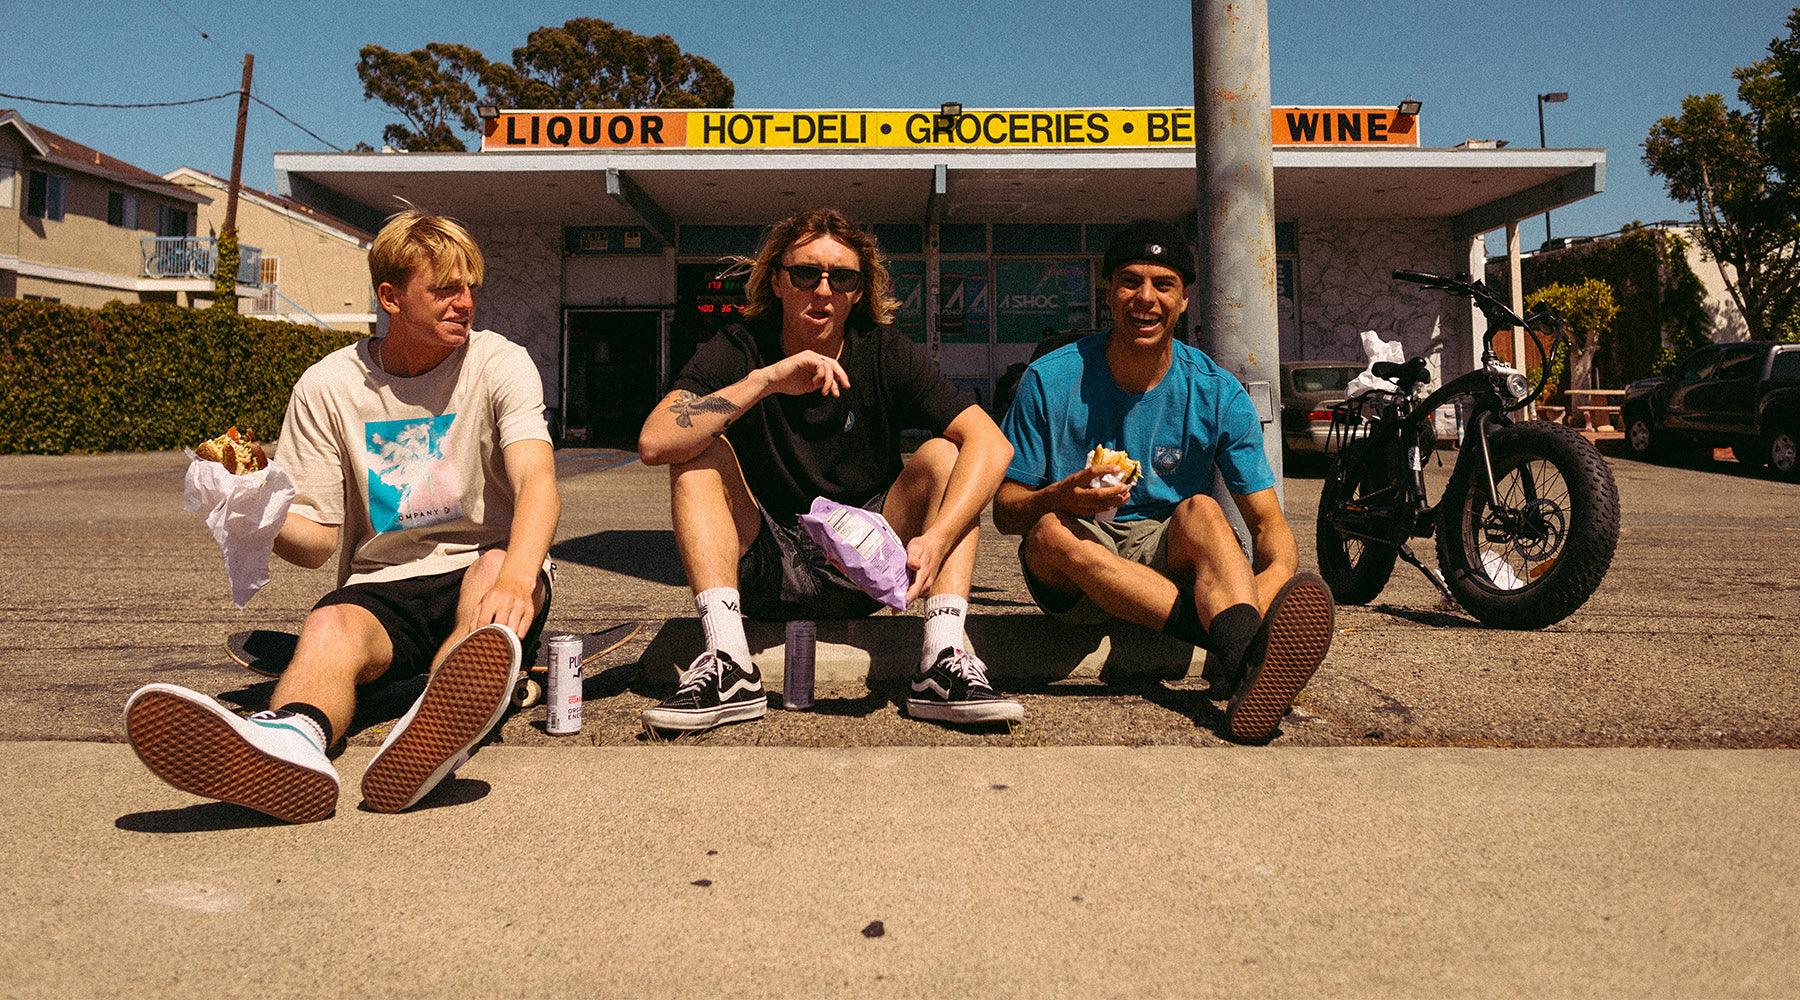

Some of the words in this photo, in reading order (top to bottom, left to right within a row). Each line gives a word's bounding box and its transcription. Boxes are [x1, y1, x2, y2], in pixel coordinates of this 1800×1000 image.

[506, 115, 665, 147] LIQUOR
[703, 113, 867, 144] HOT-DELI
[905, 112, 1110, 144] GROCERIES
[1147, 112, 1193, 142] BE
[1285, 112, 1389, 142] WINE
[393, 509, 439, 522] COMPANY
[721, 600, 739, 613] VA
